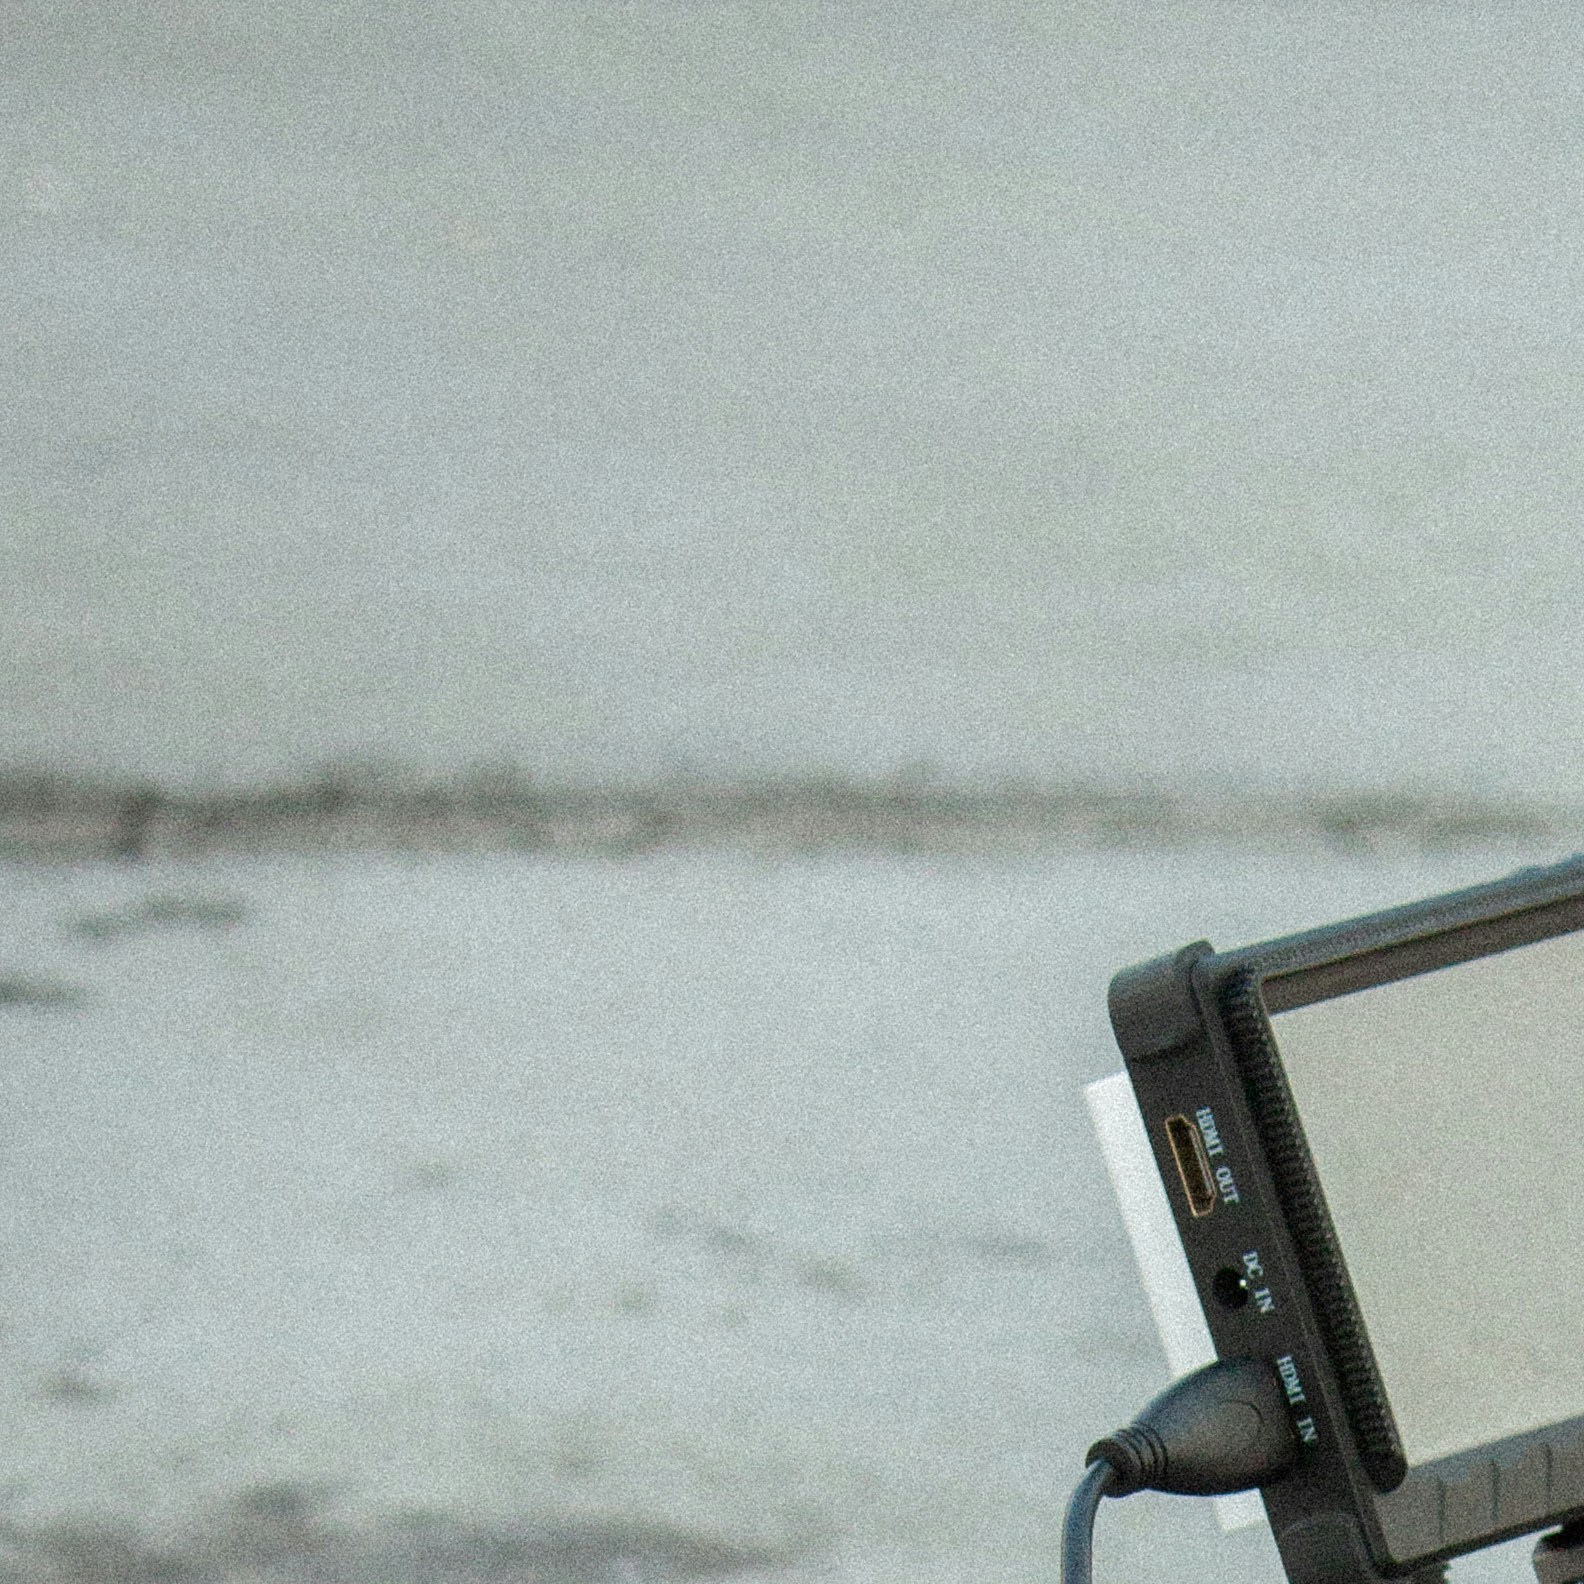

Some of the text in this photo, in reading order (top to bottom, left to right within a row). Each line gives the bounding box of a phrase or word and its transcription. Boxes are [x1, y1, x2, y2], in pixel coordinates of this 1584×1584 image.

[1196, 1106, 1240, 1204] HDMI OUT
[1242, 1250, 1275, 1314] DC IN
[1276, 1355, 1318, 1445] HDMI IN
